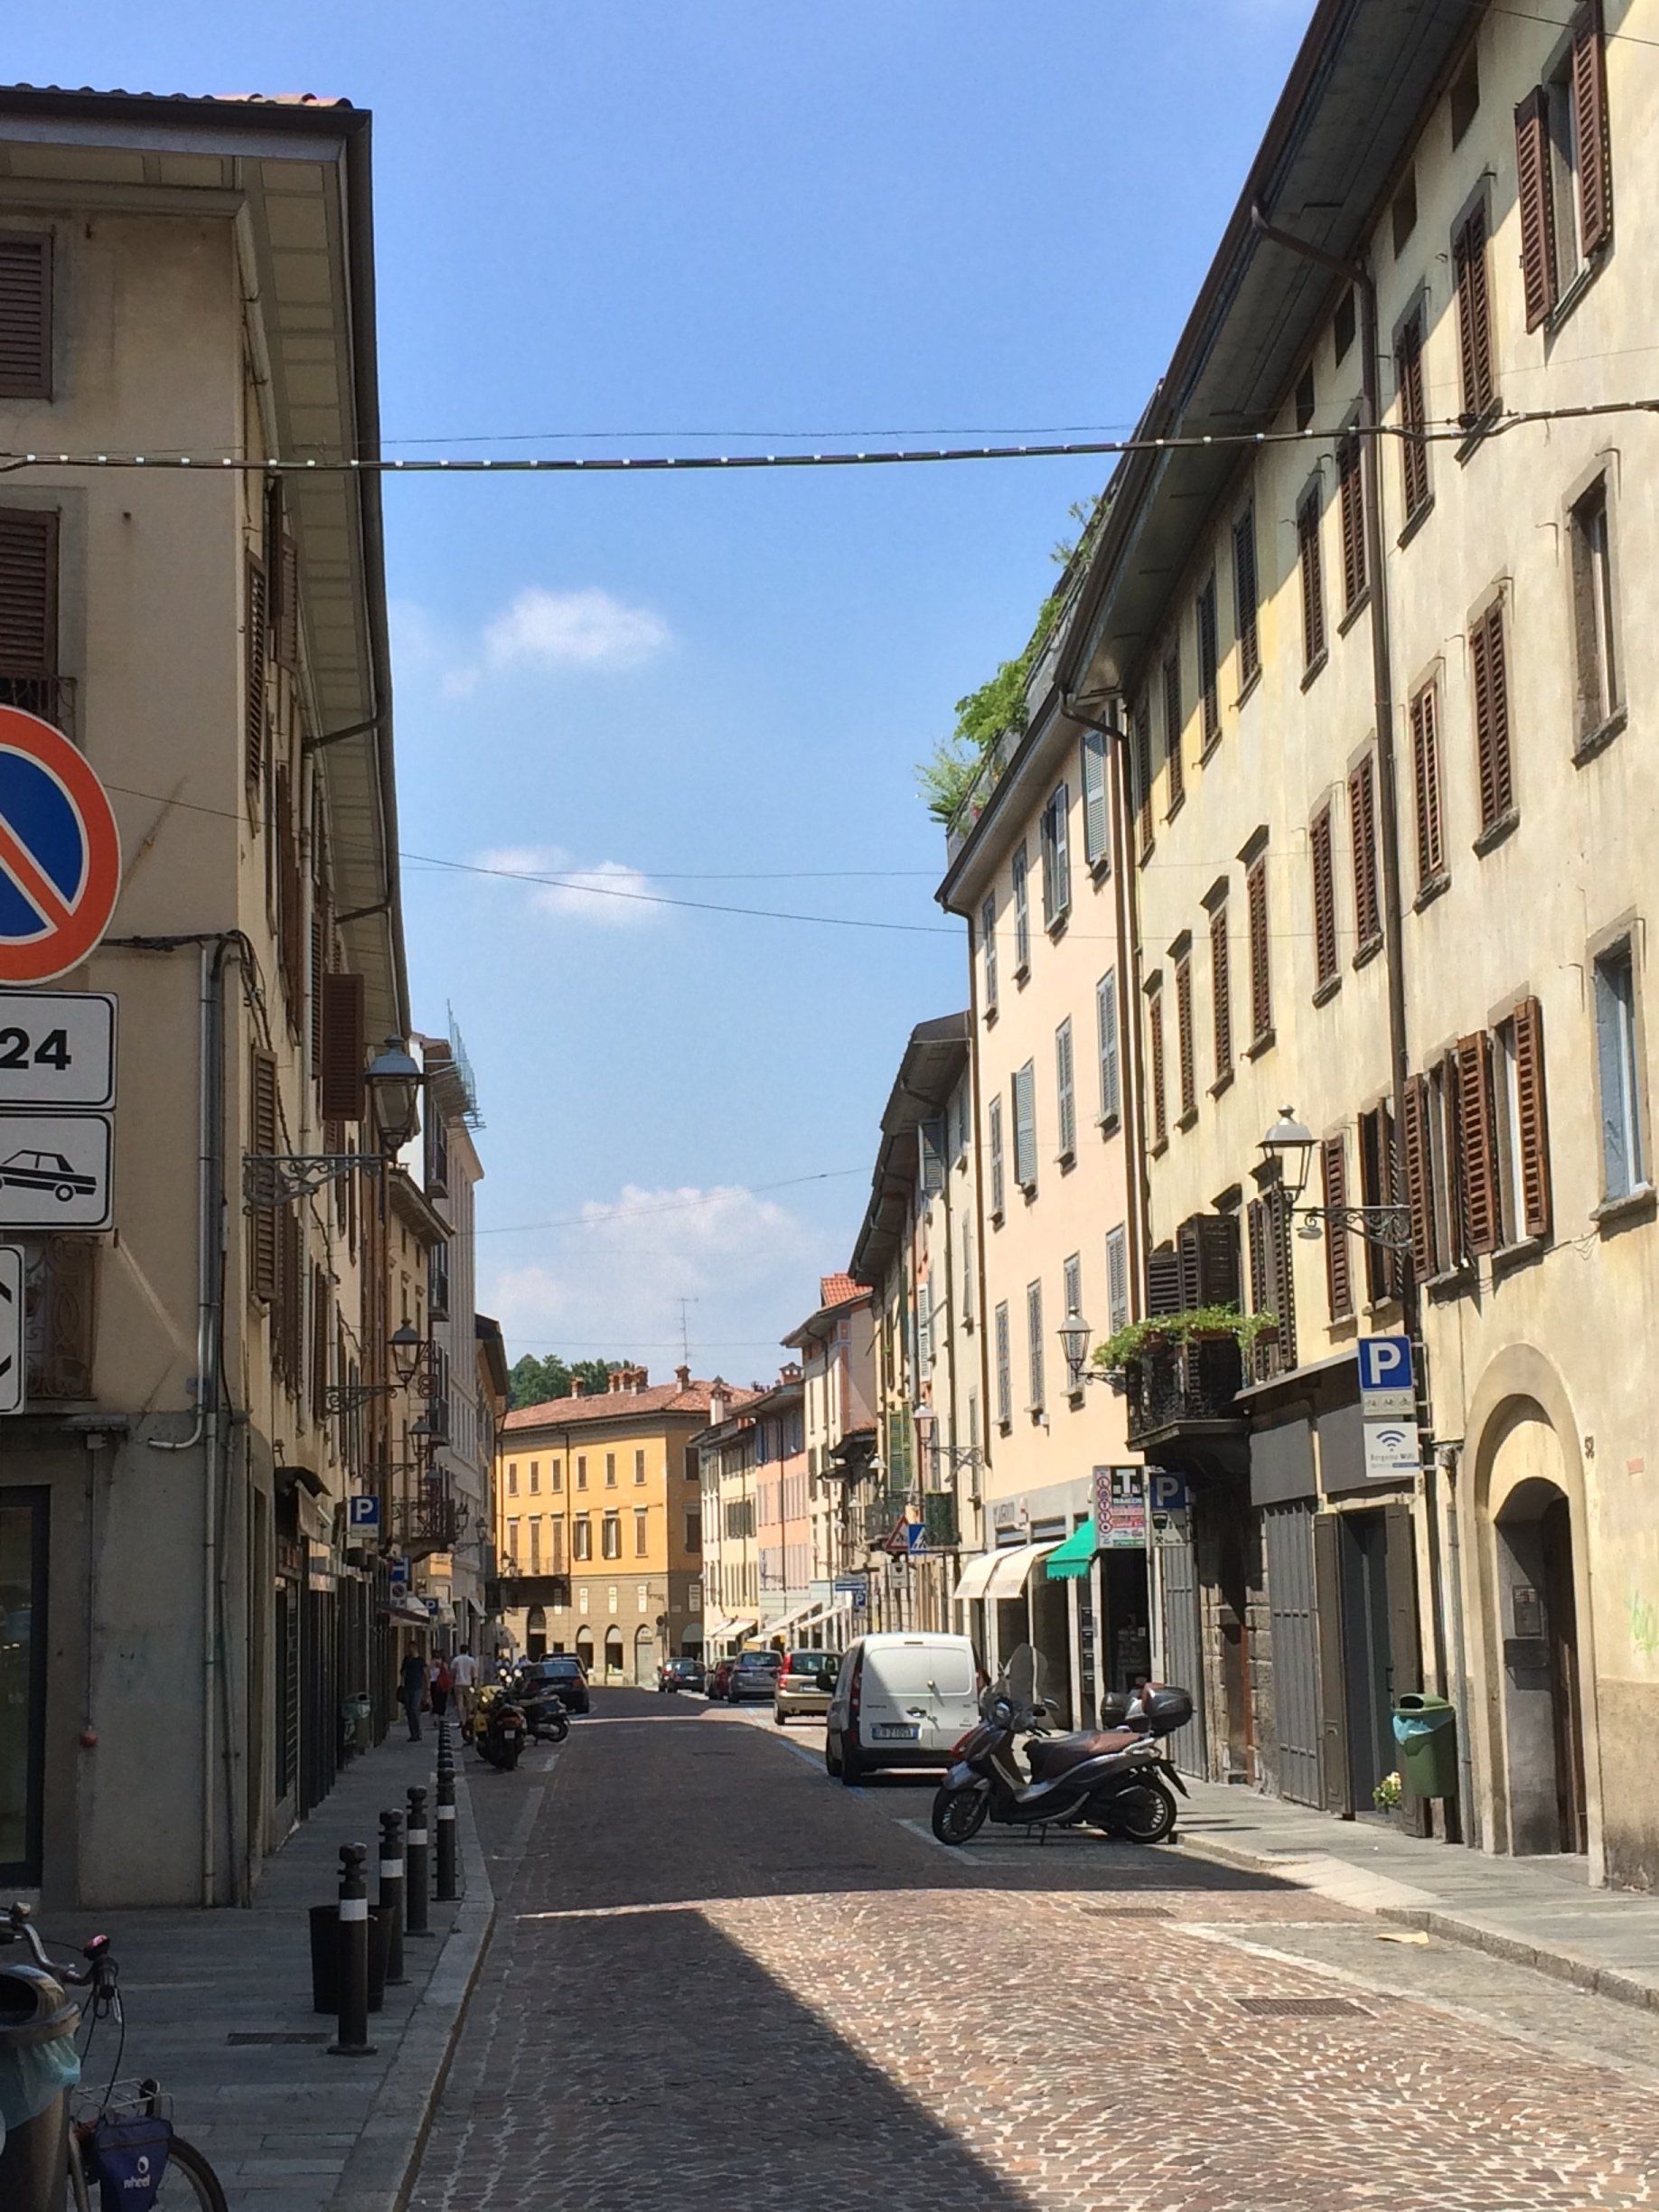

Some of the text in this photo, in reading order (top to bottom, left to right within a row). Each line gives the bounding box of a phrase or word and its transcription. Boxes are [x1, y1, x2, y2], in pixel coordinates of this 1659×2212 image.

[0, 1026, 71, 1071] 24
[1369, 1342, 1401, 1384] P
[1116, 1468, 1137, 1494] T
[1157, 1476, 1179, 1506] P
[356, 1498, 373, 1522] P
[426, 1600, 436, 1613] P
[856, 1594, 864, 1606] P
